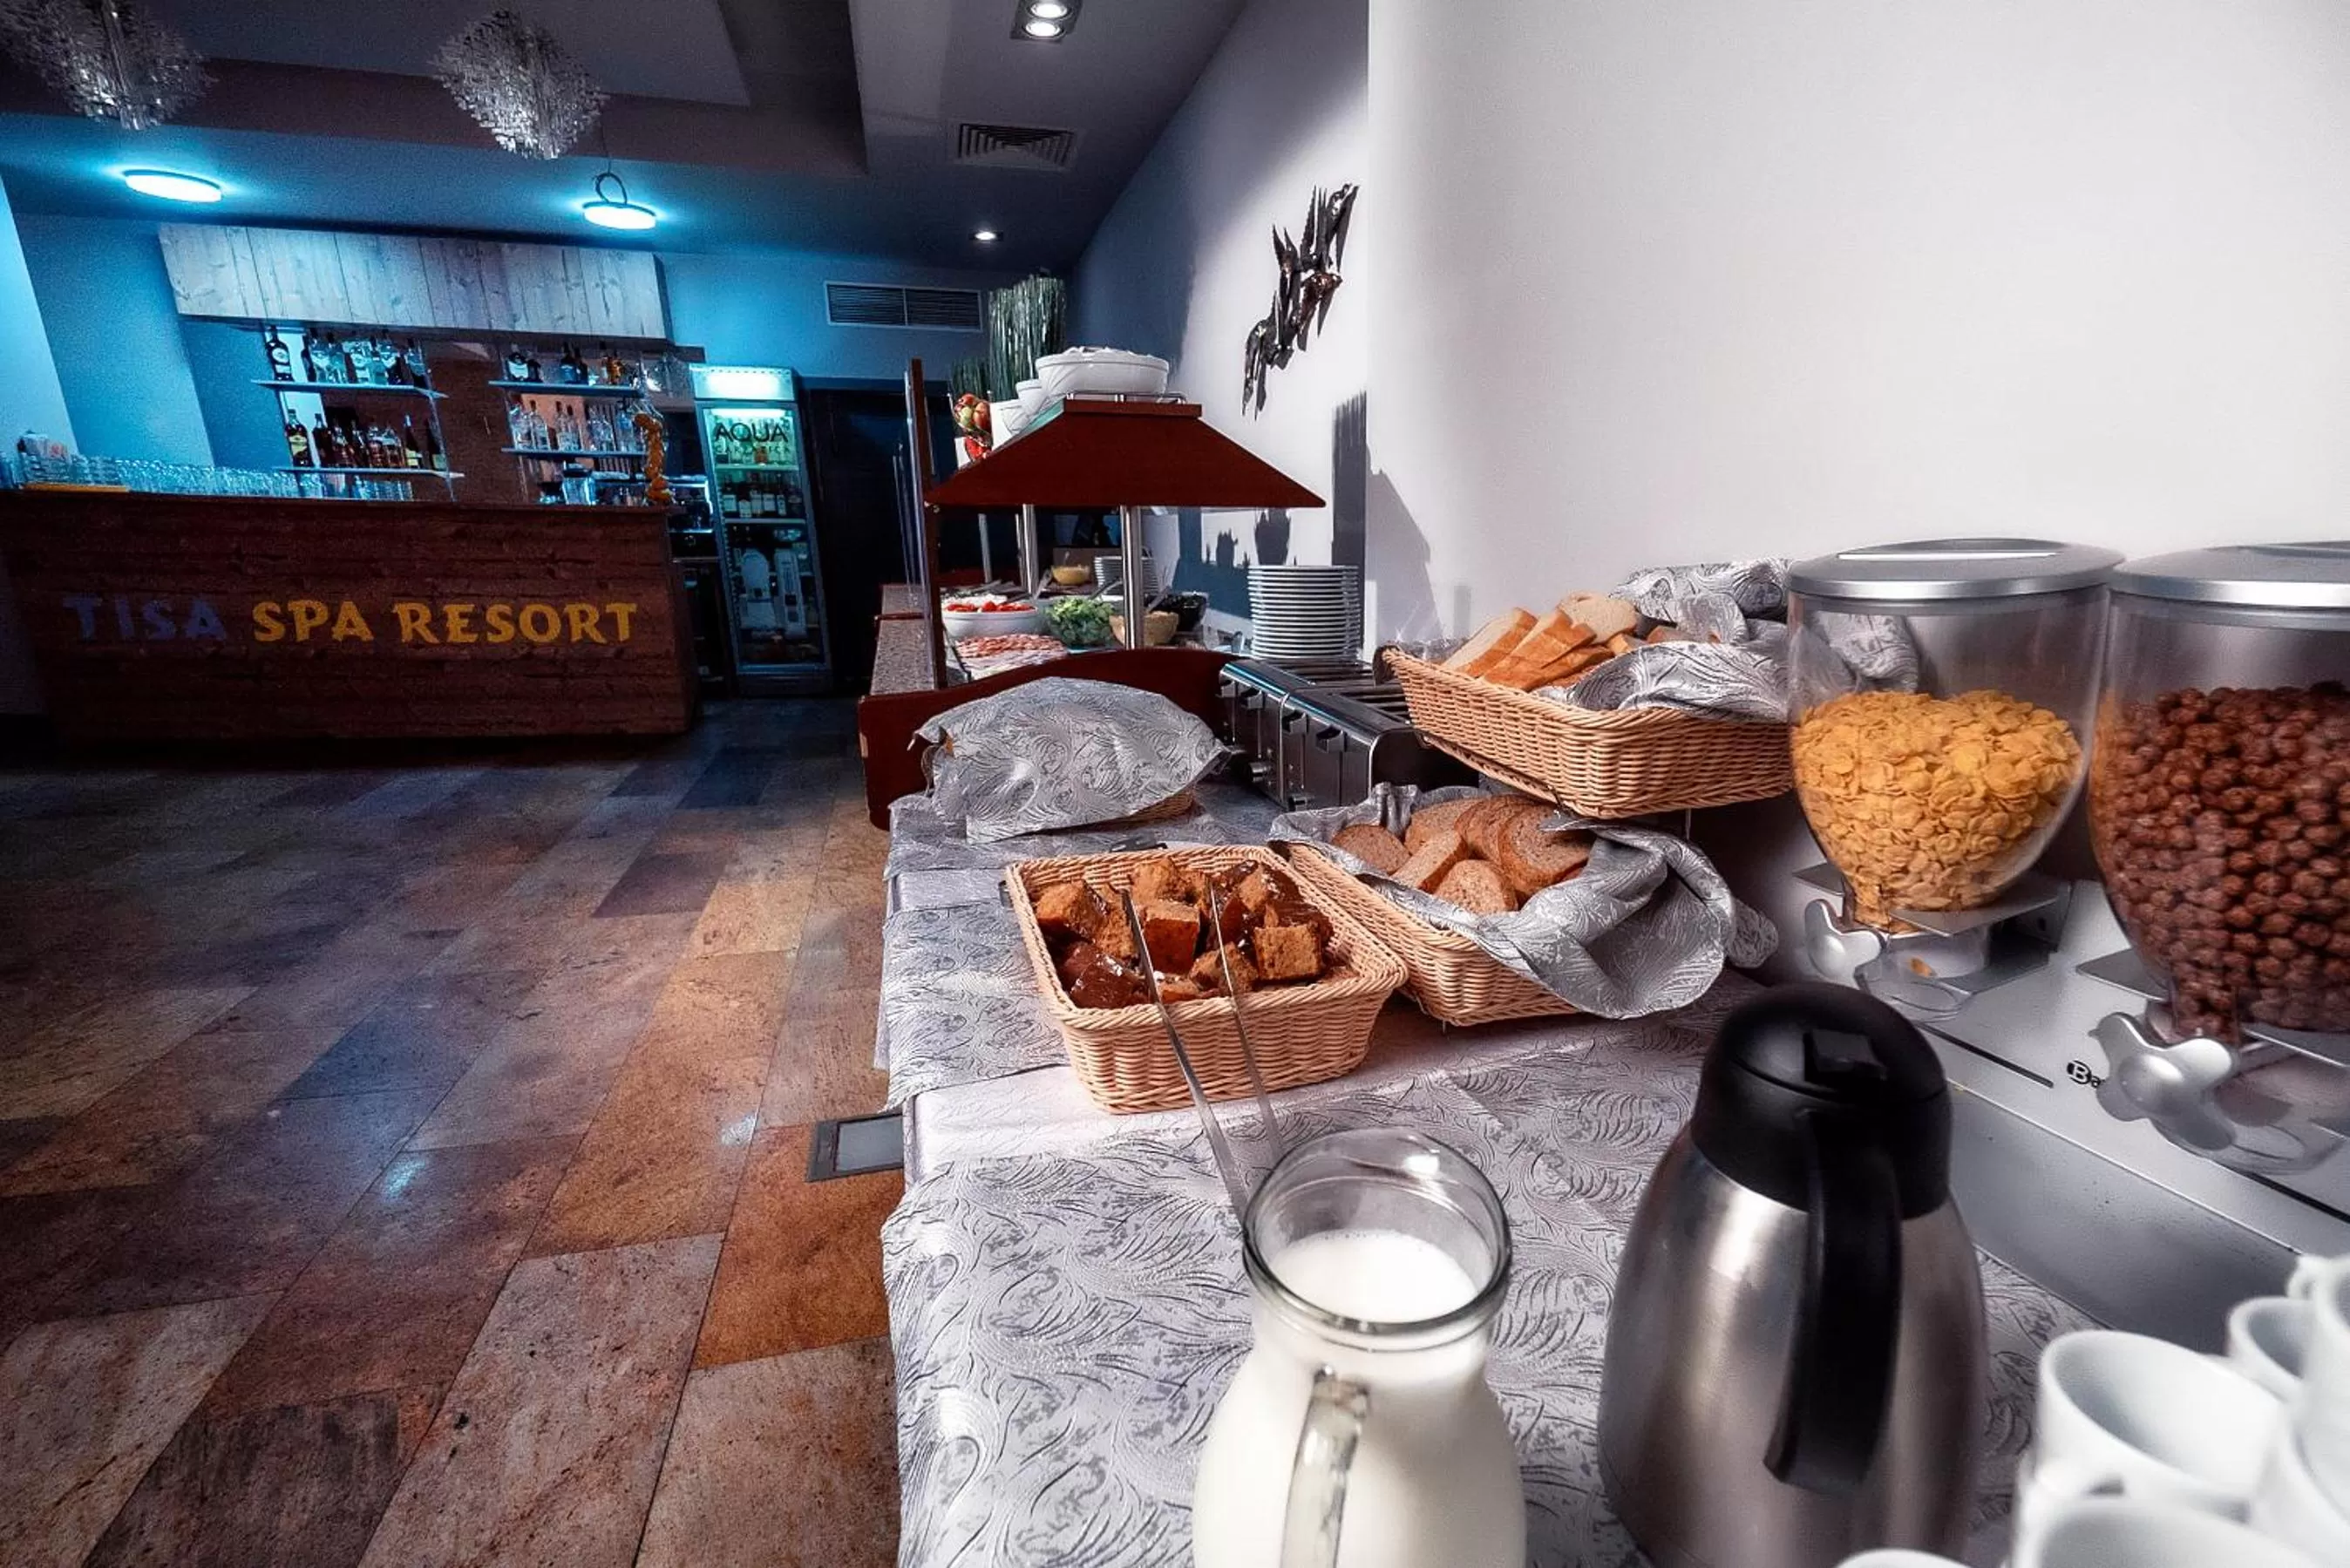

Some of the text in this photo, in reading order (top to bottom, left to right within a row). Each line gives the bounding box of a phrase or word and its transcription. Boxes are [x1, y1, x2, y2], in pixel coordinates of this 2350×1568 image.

[715, 422, 788, 443] AQUA
[62, 595, 637, 644] TISA SPA RESORT
